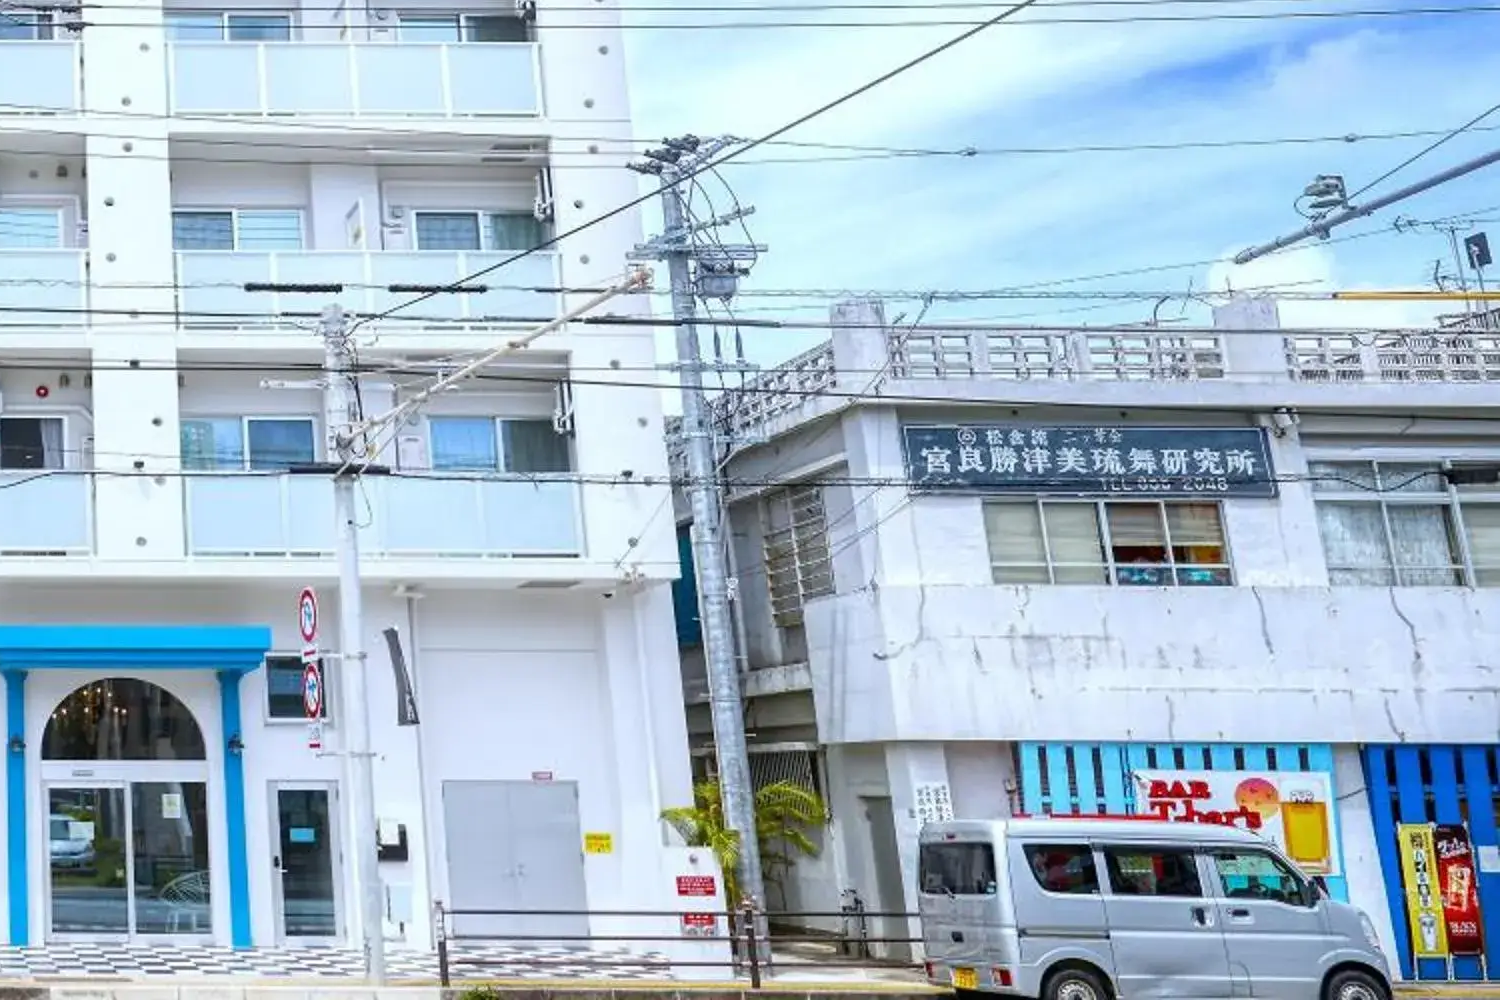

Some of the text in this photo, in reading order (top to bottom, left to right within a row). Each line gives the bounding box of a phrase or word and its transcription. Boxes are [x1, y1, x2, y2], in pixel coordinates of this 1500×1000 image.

[921, 446, 1257, 476] 宮良勝津美琉舞研究所
[1099, 477, 1131, 491] TEL
[1149, 779, 1211, 799] BAR
